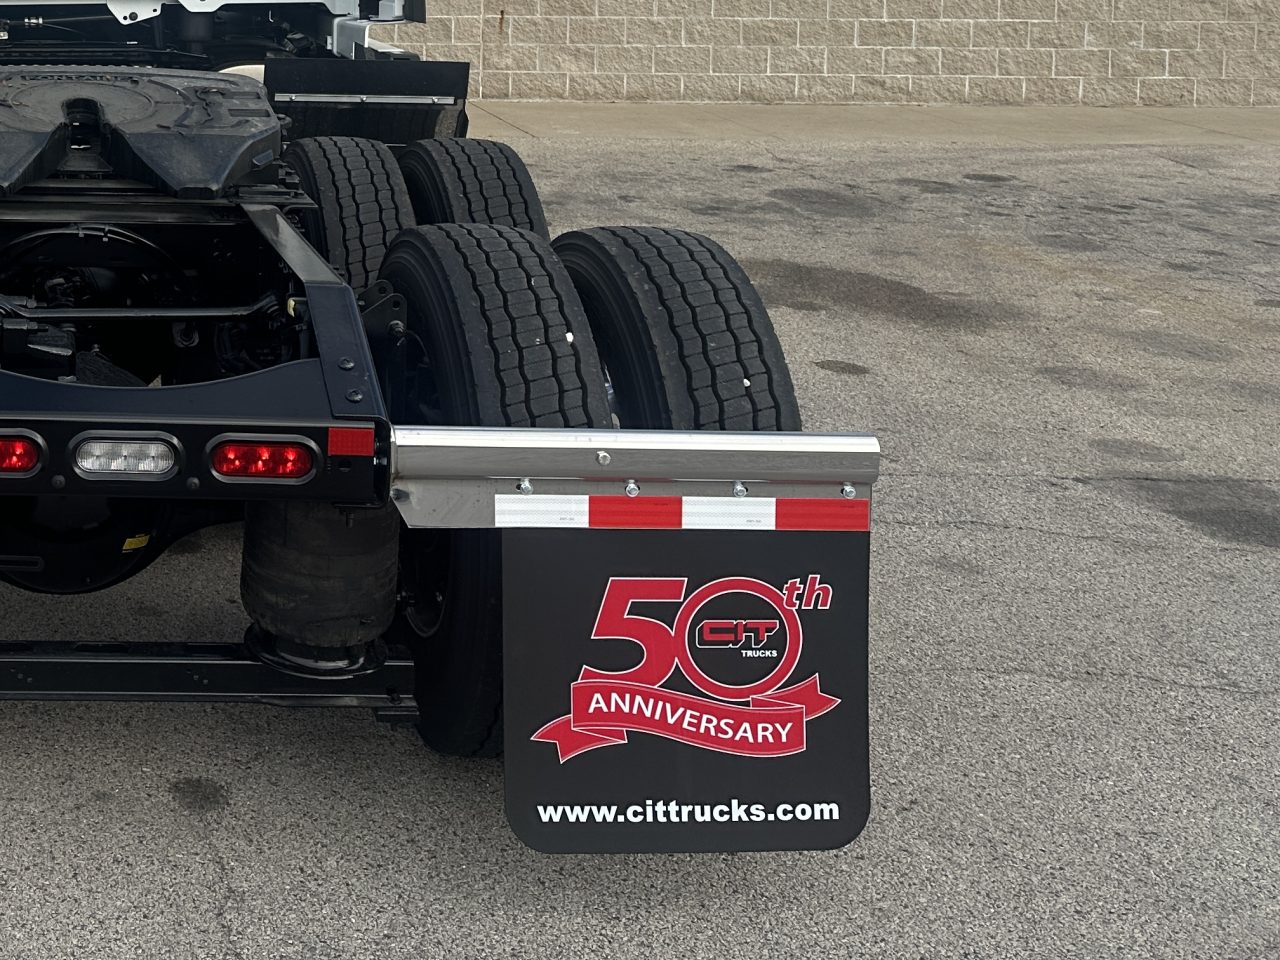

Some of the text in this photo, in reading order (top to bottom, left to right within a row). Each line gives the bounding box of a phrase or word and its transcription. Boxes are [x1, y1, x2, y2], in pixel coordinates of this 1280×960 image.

[696, 620, 779, 648] CIT
[587, 692, 793, 744] ANNIVERSARY
[537, 799, 839, 822] www.cittrucks.com
